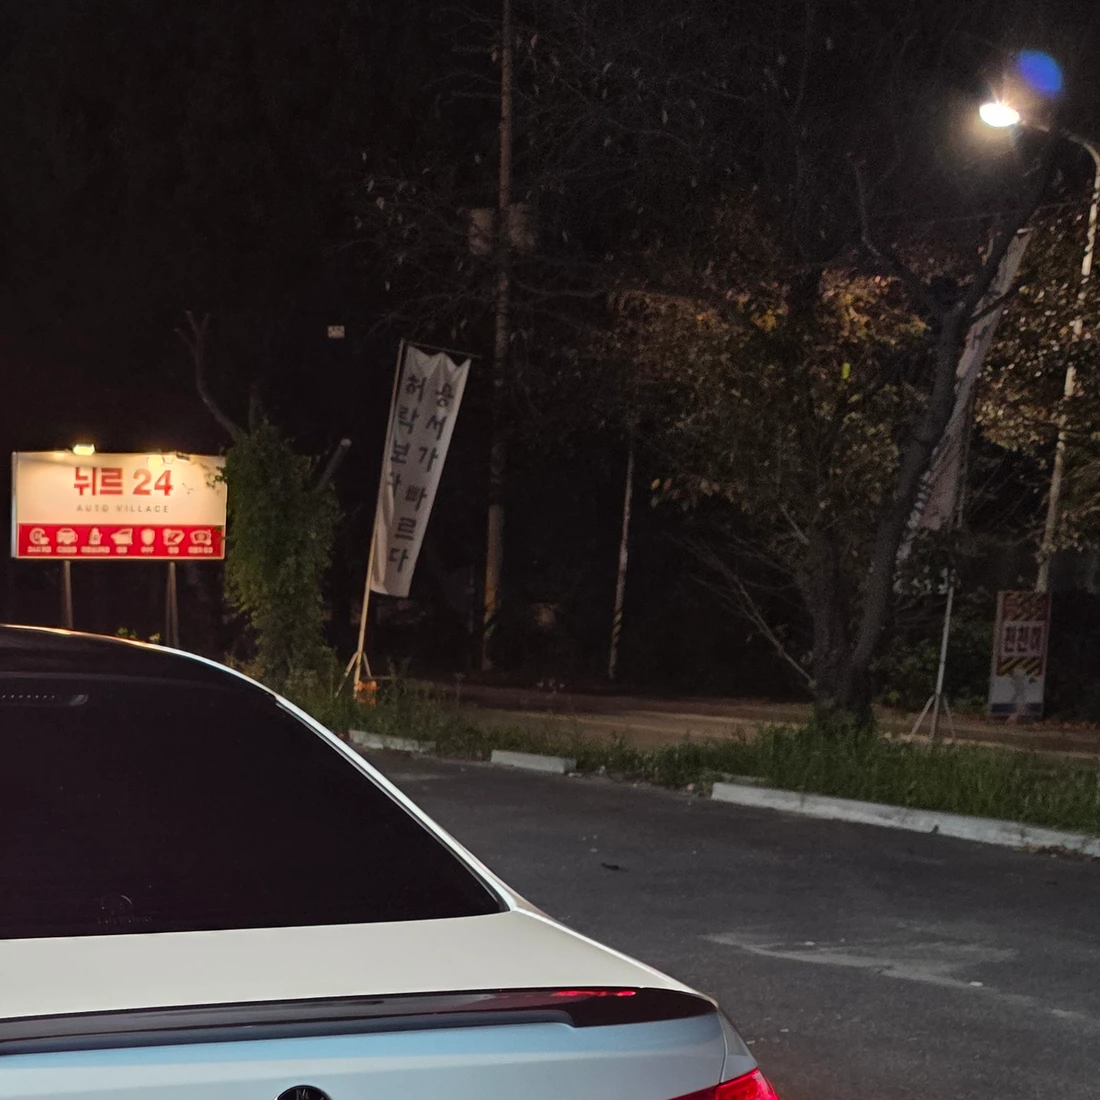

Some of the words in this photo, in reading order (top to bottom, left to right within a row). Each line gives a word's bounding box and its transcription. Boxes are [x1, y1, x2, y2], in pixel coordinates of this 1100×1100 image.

[73, 467, 123, 496] 뉘르
[132, 468, 174, 496] 24
[76, 504, 110, 513] AUTO
[116, 504, 169, 513] VILLAGE
[388, 485, 427, 573] 빠르다
